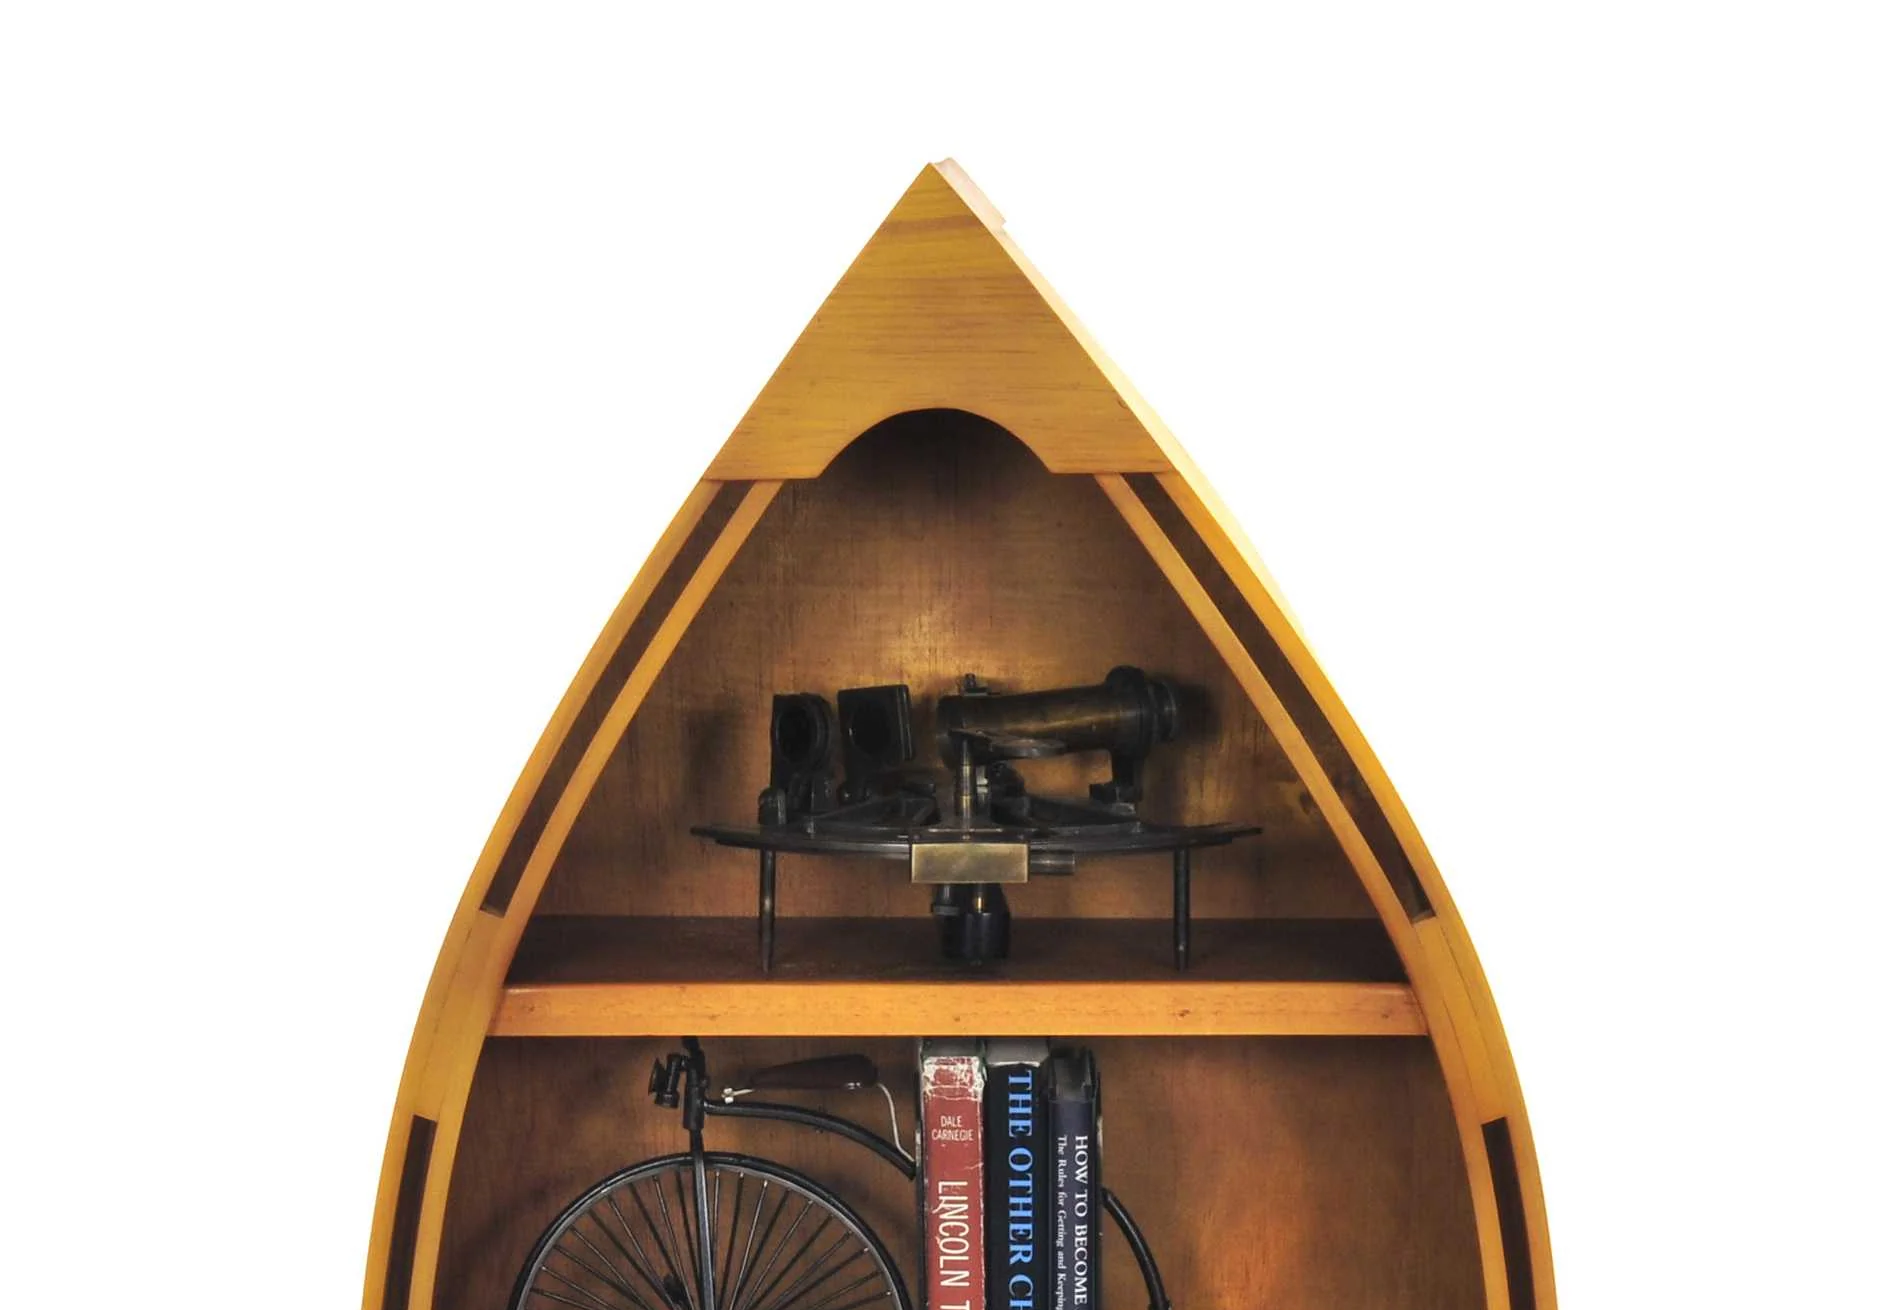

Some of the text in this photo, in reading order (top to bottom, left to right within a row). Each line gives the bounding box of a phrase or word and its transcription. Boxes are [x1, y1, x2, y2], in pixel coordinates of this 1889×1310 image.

[1008, 1070, 1033, 1138] THE
[931, 1128, 974, 1142] CARNEGIE
[940, 1115, 962, 1128] DALE
[1056, 1135, 1067, 1155] The
[1074, 1135, 1088, 1185] HOW
[1057, 1158, 1067, 1189] Rules
[1008, 1147, 1034, 1265] OTHER
[1057, 1192, 1067, 1207] for
[1074, 1192, 1088, 1218] TO
[938, 1181, 970, 1287] LINCOLN
[1055, 1210, 1067, 1247] Getting
[1057, 1251, 1067, 1270] and
[1074, 1225, 1088, 1305] BECOME
